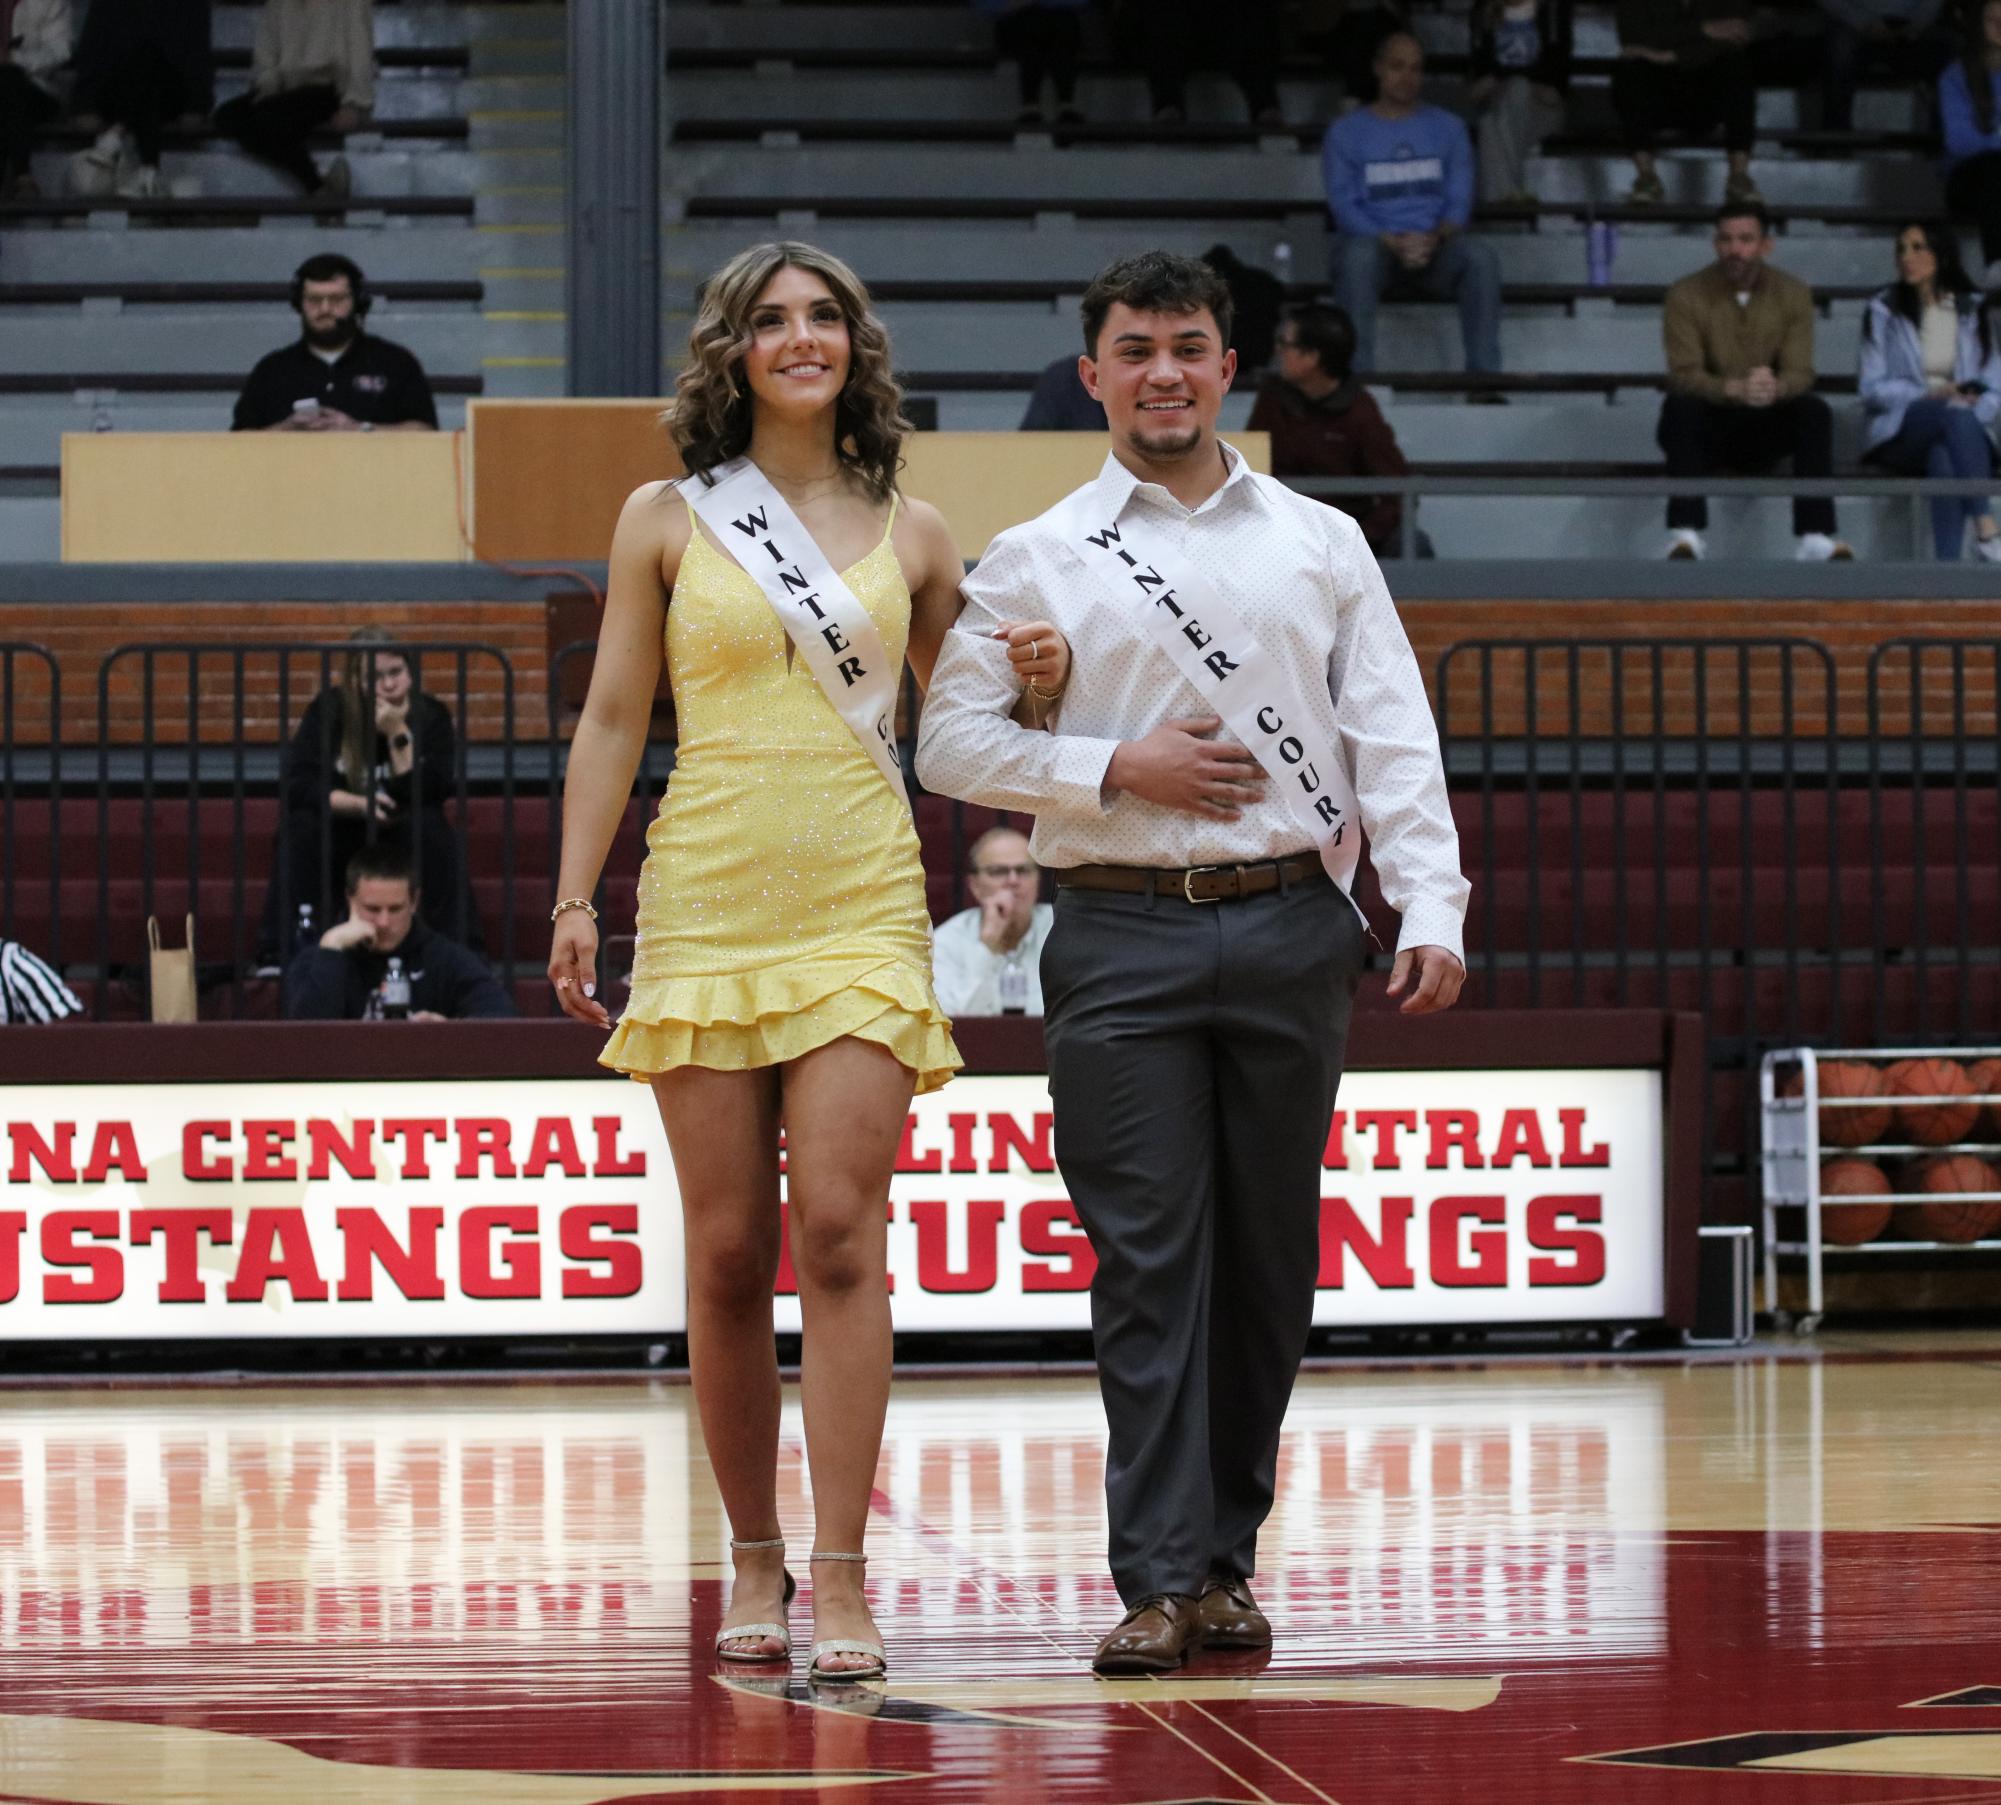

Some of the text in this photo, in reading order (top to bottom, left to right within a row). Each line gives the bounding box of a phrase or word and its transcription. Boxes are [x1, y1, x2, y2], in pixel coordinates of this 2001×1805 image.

[731, 505, 867, 687] WINTER
[1085, 521, 1346, 848] WINTER COURT
[182, 1115, 646, 1182] CENTRAL
[1321, 1107, 1610, 1170] TRAL
[0, 1204, 643, 1306] STANGS
